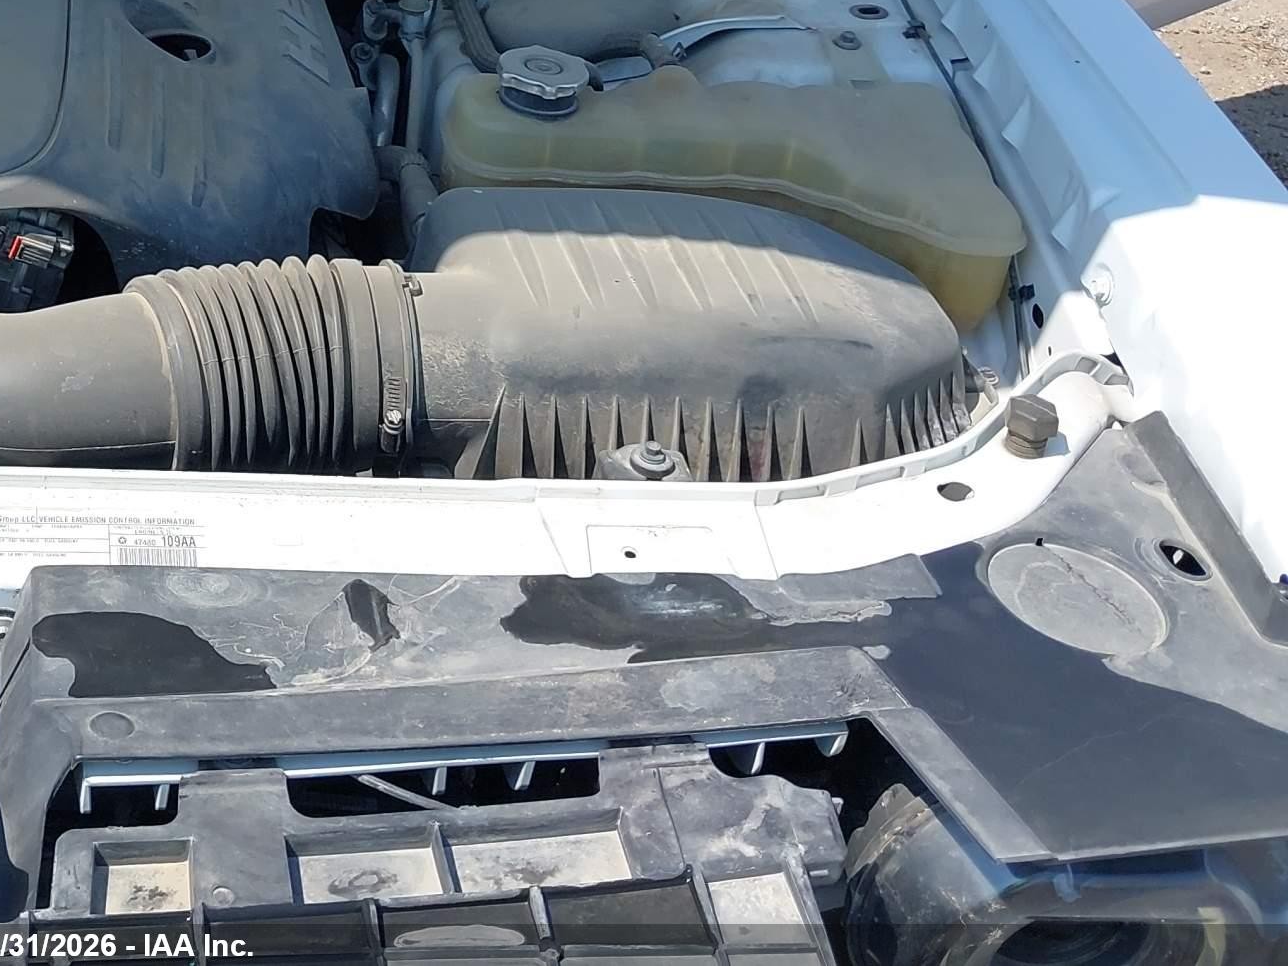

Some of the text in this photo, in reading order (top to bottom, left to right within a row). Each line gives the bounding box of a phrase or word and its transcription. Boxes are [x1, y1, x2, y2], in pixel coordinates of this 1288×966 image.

[22, 515, 36, 523] LLC
[71, 516, 106, 524] EMISSION
[108, 516, 142, 524] CONTROL
[144, 517, 195, 525] INFORMATION
[162, 535, 197, 547] 109AA
